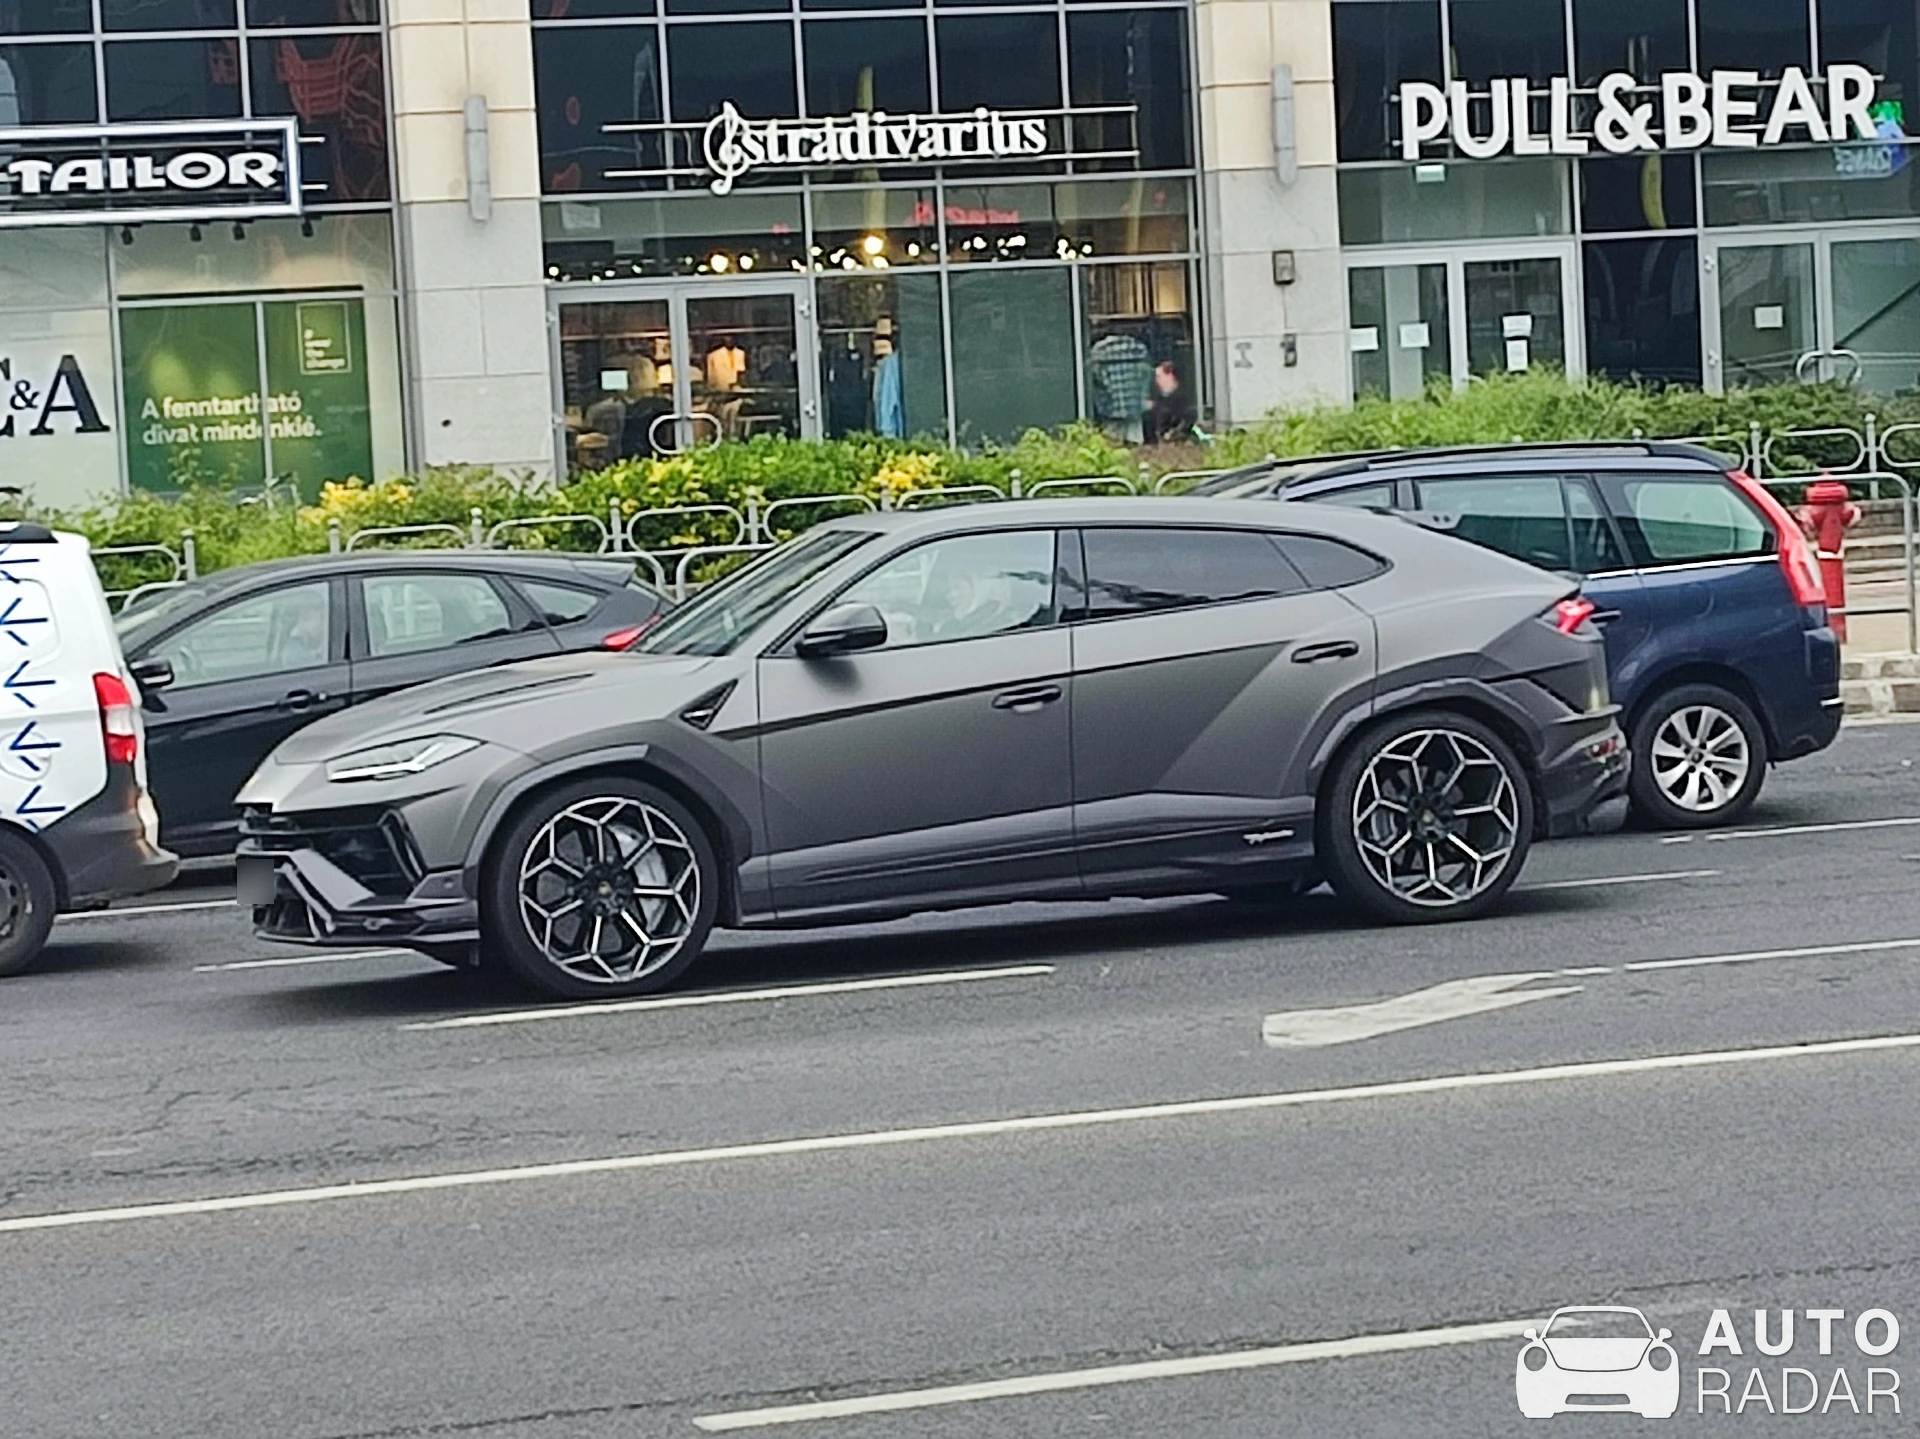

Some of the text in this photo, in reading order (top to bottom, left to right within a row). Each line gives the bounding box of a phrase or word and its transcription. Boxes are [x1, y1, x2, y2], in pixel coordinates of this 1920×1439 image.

[1400, 64, 1878, 160] PULL&BEAR
[8, 151, 279, 194] TAILOR
[141, 398, 160, 420] A
[143, 423, 200, 446] divat
